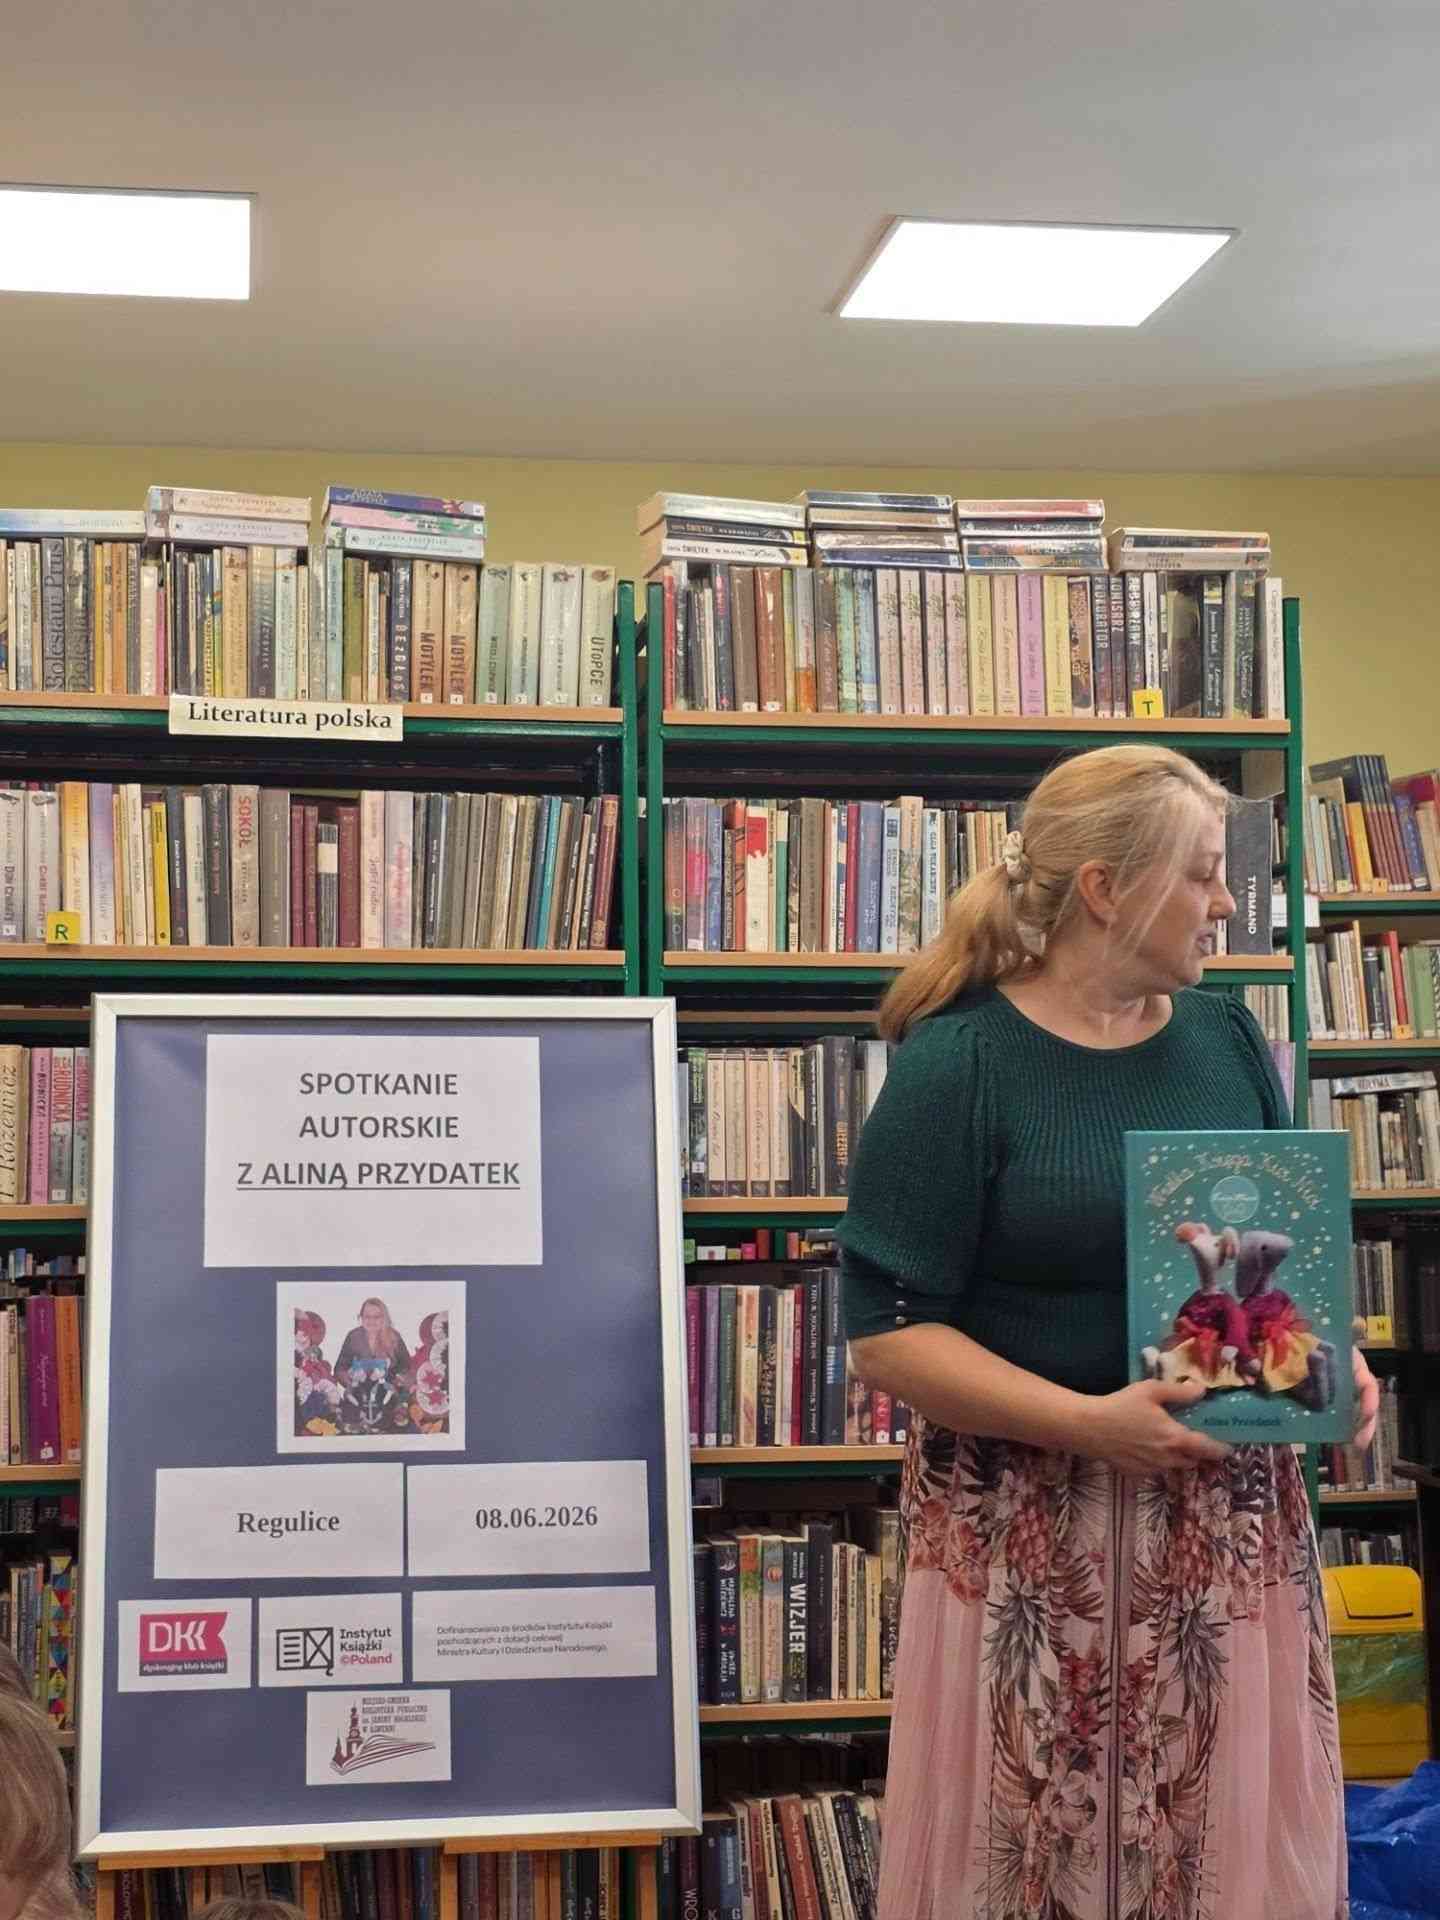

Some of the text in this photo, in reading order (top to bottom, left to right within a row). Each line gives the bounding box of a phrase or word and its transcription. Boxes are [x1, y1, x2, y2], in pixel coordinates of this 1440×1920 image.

[1111, 577, 1124, 633] KOMISARZ
[420, 631, 436, 690] MOTYLEK
[451, 634, 467, 693] MOTYLEK
[189, 702, 392, 731] Literatura polska
[1142, 700, 1154, 715] T
[1247, 874, 1257, 936] TYRMAND
[55, 923, 69, 941] R
[299, 1072, 459, 1096] SPOTKANIE
[298, 1115, 459, 1139] AUTORSKIE
[237, 1162, 521, 1189] Z ALINĄ PRZYDATEK
[237, 1510, 340, 1539] Regulice
[475, 1505, 598, 1530] 08.06.2026
[789, 1582, 807, 1653] WIZJER
[340, 1627, 392, 1642] Instytut
[340, 1640, 383, 1654] Książki
